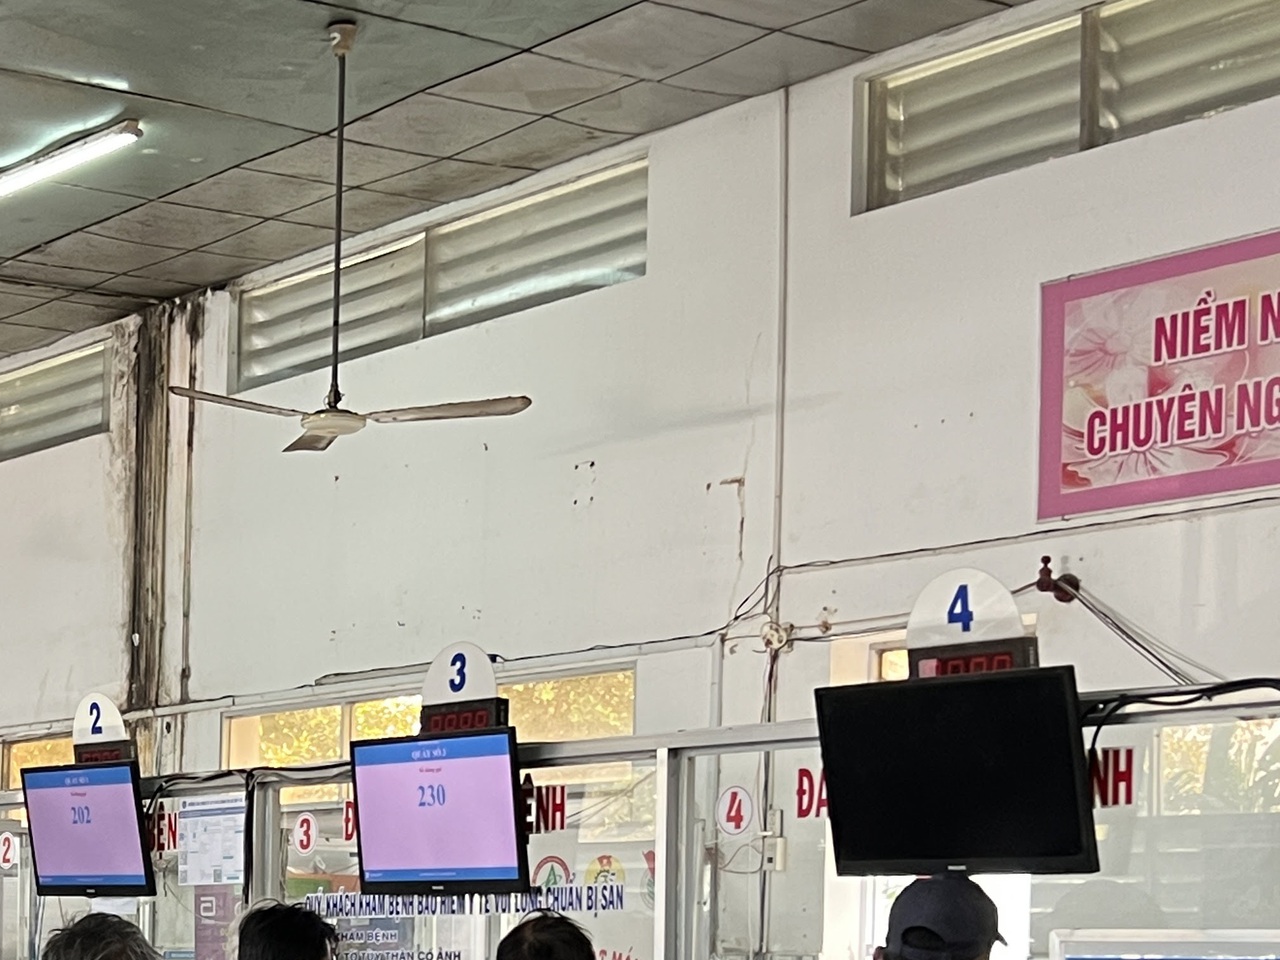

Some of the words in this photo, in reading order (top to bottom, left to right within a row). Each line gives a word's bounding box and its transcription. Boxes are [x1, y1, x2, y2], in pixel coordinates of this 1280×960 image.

[1153, 290, 1246, 362] NIỀM
[1086, 383, 1223, 455] CHUYÊN
[947, 584, 973, 632] 4
[449, 652, 466, 693] 3
[89, 702, 102, 735] 2
[417, 784, 446, 807] 230
[1088, 748, 1133, 808] NH
[71, 806, 92, 825] 202
[521, 773, 565, 833] ỆNH
[725, 791, 744, 829] 4
[2, 836, 11, 864] 2
[147, 801, 177, 860] BỆN
[299, 817, 311, 851] 3
